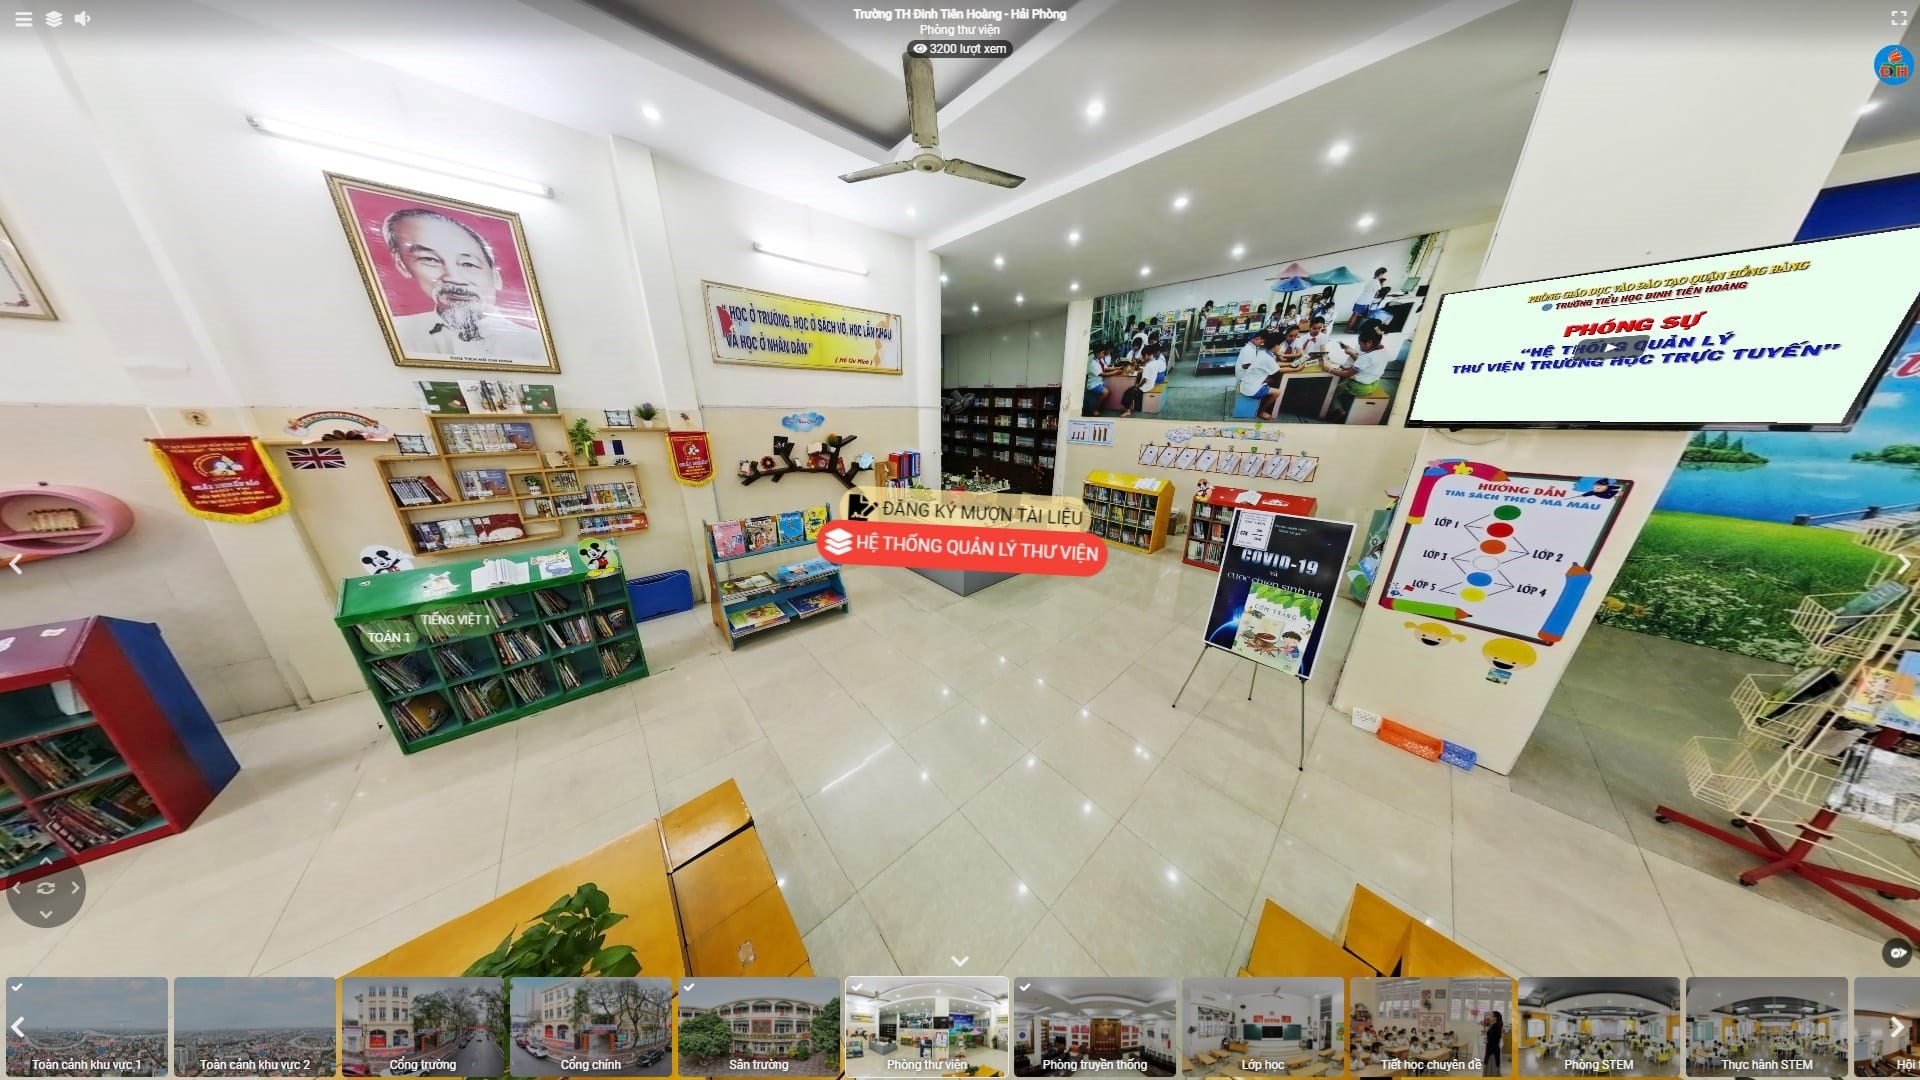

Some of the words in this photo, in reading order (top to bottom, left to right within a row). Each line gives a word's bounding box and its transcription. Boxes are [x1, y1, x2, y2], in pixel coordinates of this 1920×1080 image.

[1689, 271, 1725, 285] QUẬN
[1555, 299, 1593, 310] TRƯỜNG
[1595, 293, 1618, 305] TIỂU
[1620, 293, 1643, 304] HỌC
[1675, 285, 1703, 296] TIÊN
[1705, 281, 1749, 293] HOÀNG
[729, 305, 748, 325] HỌC
[792, 316, 809, 333] HỌC
[818, 317, 836, 333] SÁCH
[849, 323, 862, 340] HỌC
[1563, 318, 1655, 337] PHÓNG
[1660, 310, 1707, 331] SỰ
[740, 335, 758, 354] HỌC
[767, 336, 790, 353] NHÂN
[1633, 335, 1693, 353] QUẢN
[1702, 331, 1736, 346] LÝ
[1452, 363, 1485, 374] THƯ
[1487, 360, 1525, 373] VIỆN
[1530, 357, 1605, 370] TRƯỜNG
[1610, 354, 1655, 367] HỌC
[1661, 348, 1724, 366] TRỰC
[1478, 483, 1530, 494] HƯỚNG
[1534, 485, 1567, 498] DẪN
[1504, 495, 1537, 504] THEO
[1434, 517, 1453, 528] LỚP
[1455, 521, 1459, 529] 1
[1240, 548, 1320, 576] COVID-19
[1423, 549, 1440, 560] LỚP
[1441, 552, 1448, 561] 3
[1532, 549, 1554, 562] LỚP
[1556, 553, 1564, 563] 2
[1412, 579, 1428, 589] LỚP
[1430, 583, 1437, 591] 5
[1516, 584, 1538, 596] LỚP
[1539, 588, 1547, 597] 4
